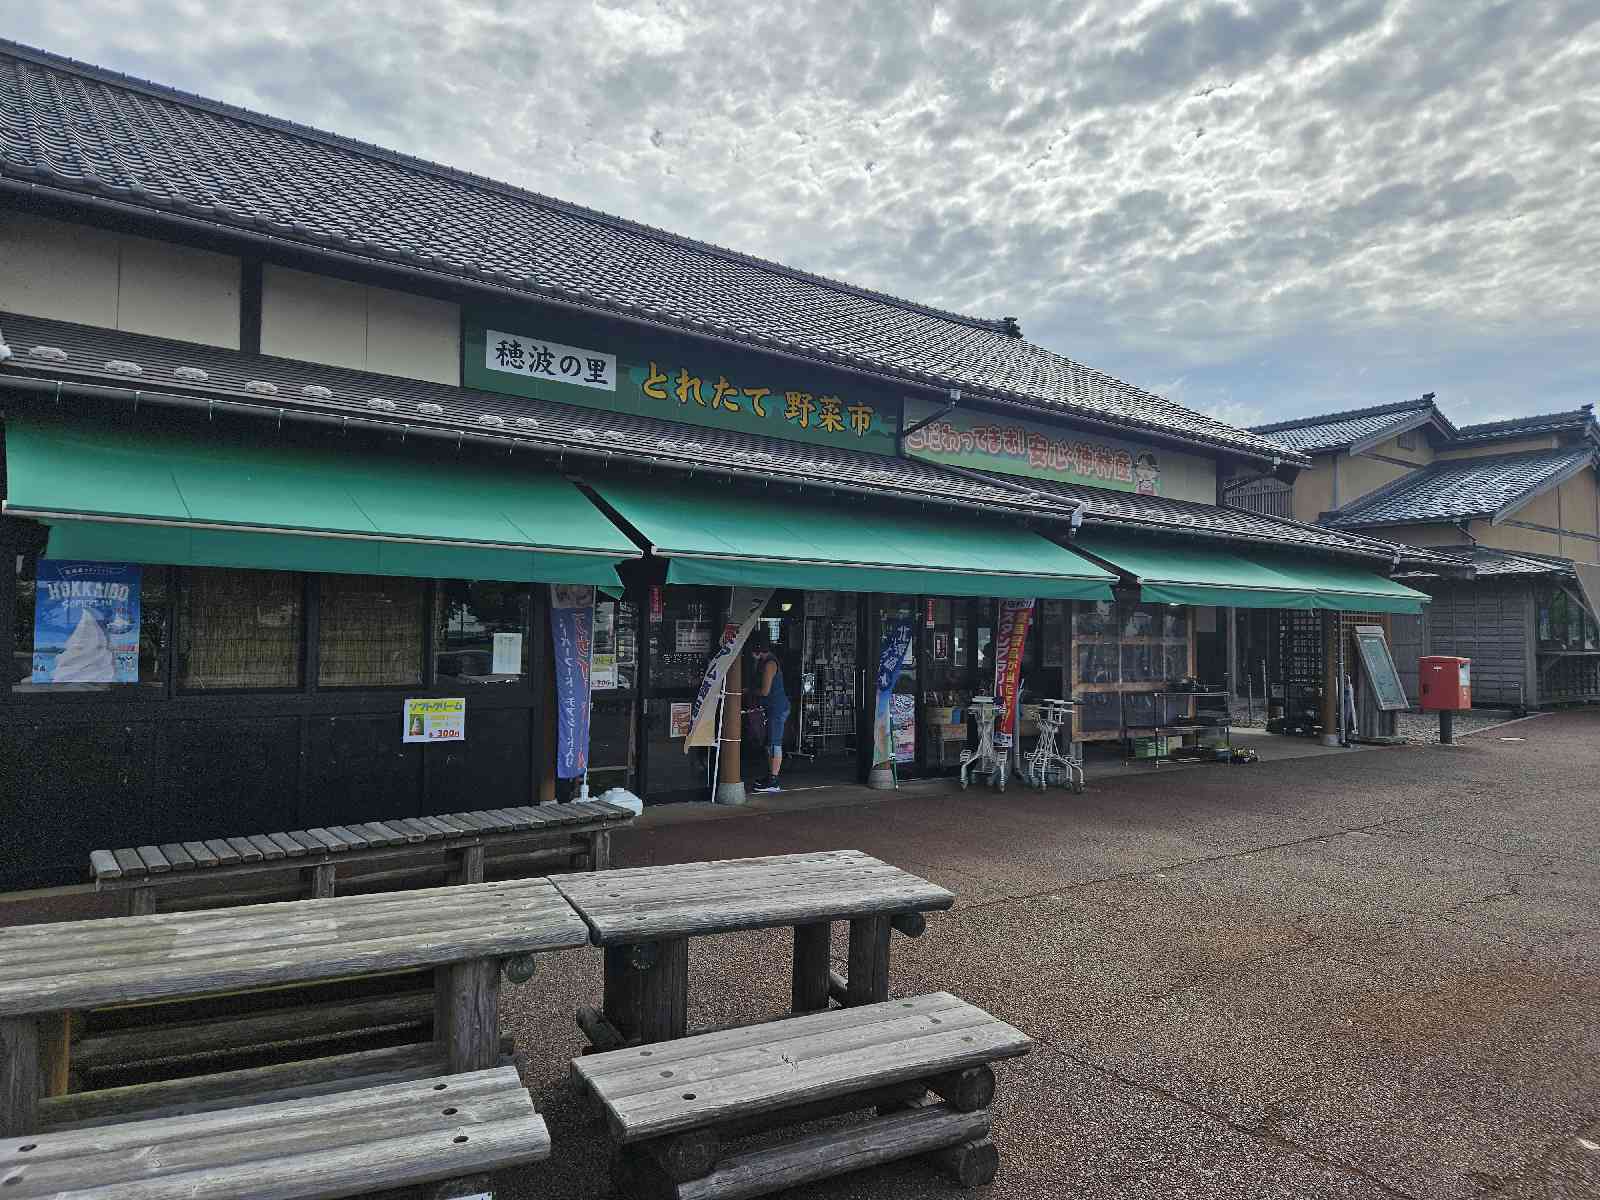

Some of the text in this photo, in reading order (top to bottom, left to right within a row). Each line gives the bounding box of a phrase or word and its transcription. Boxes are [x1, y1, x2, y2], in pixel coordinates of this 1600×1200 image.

[495, 339, 609, 384] 穂波の里
[641, 360, 875, 439] とれたて 野菜市
[47, 580, 129, 602] HOKKAIDO
